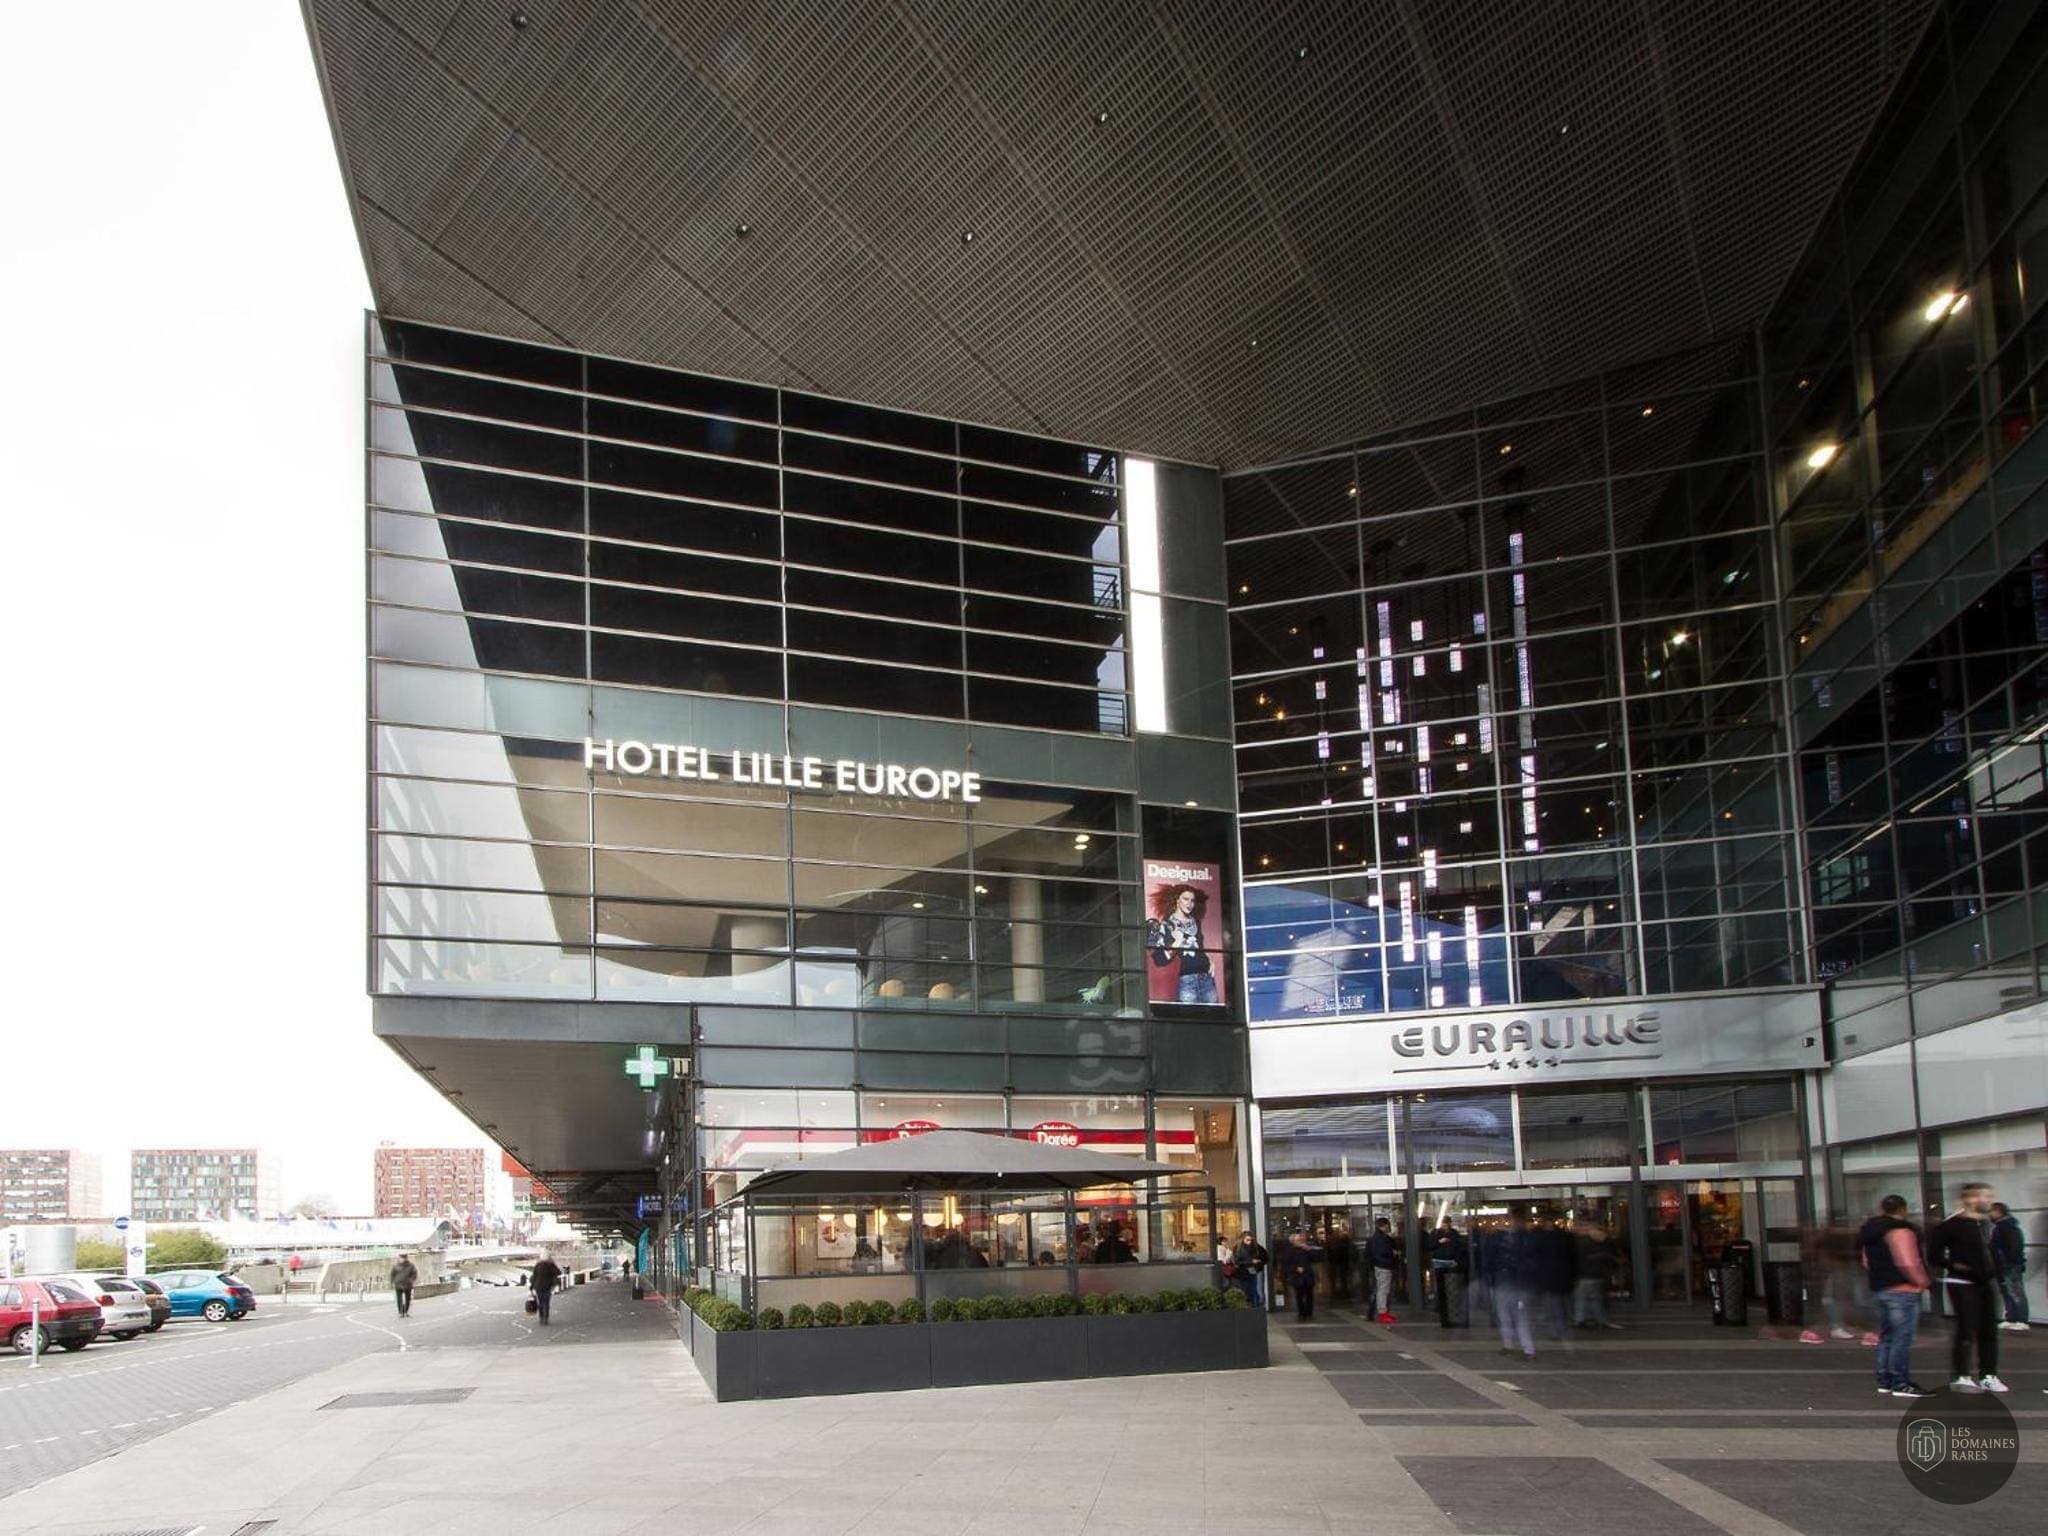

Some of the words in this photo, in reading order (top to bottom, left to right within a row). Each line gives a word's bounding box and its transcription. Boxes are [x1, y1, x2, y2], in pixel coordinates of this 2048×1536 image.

[584, 737, 720, 781] HOTEL
[732, 749, 823, 789] LILLE
[836, 759, 982, 803] EUROPE
[1390, 1010, 1663, 1058] EURALILLE
